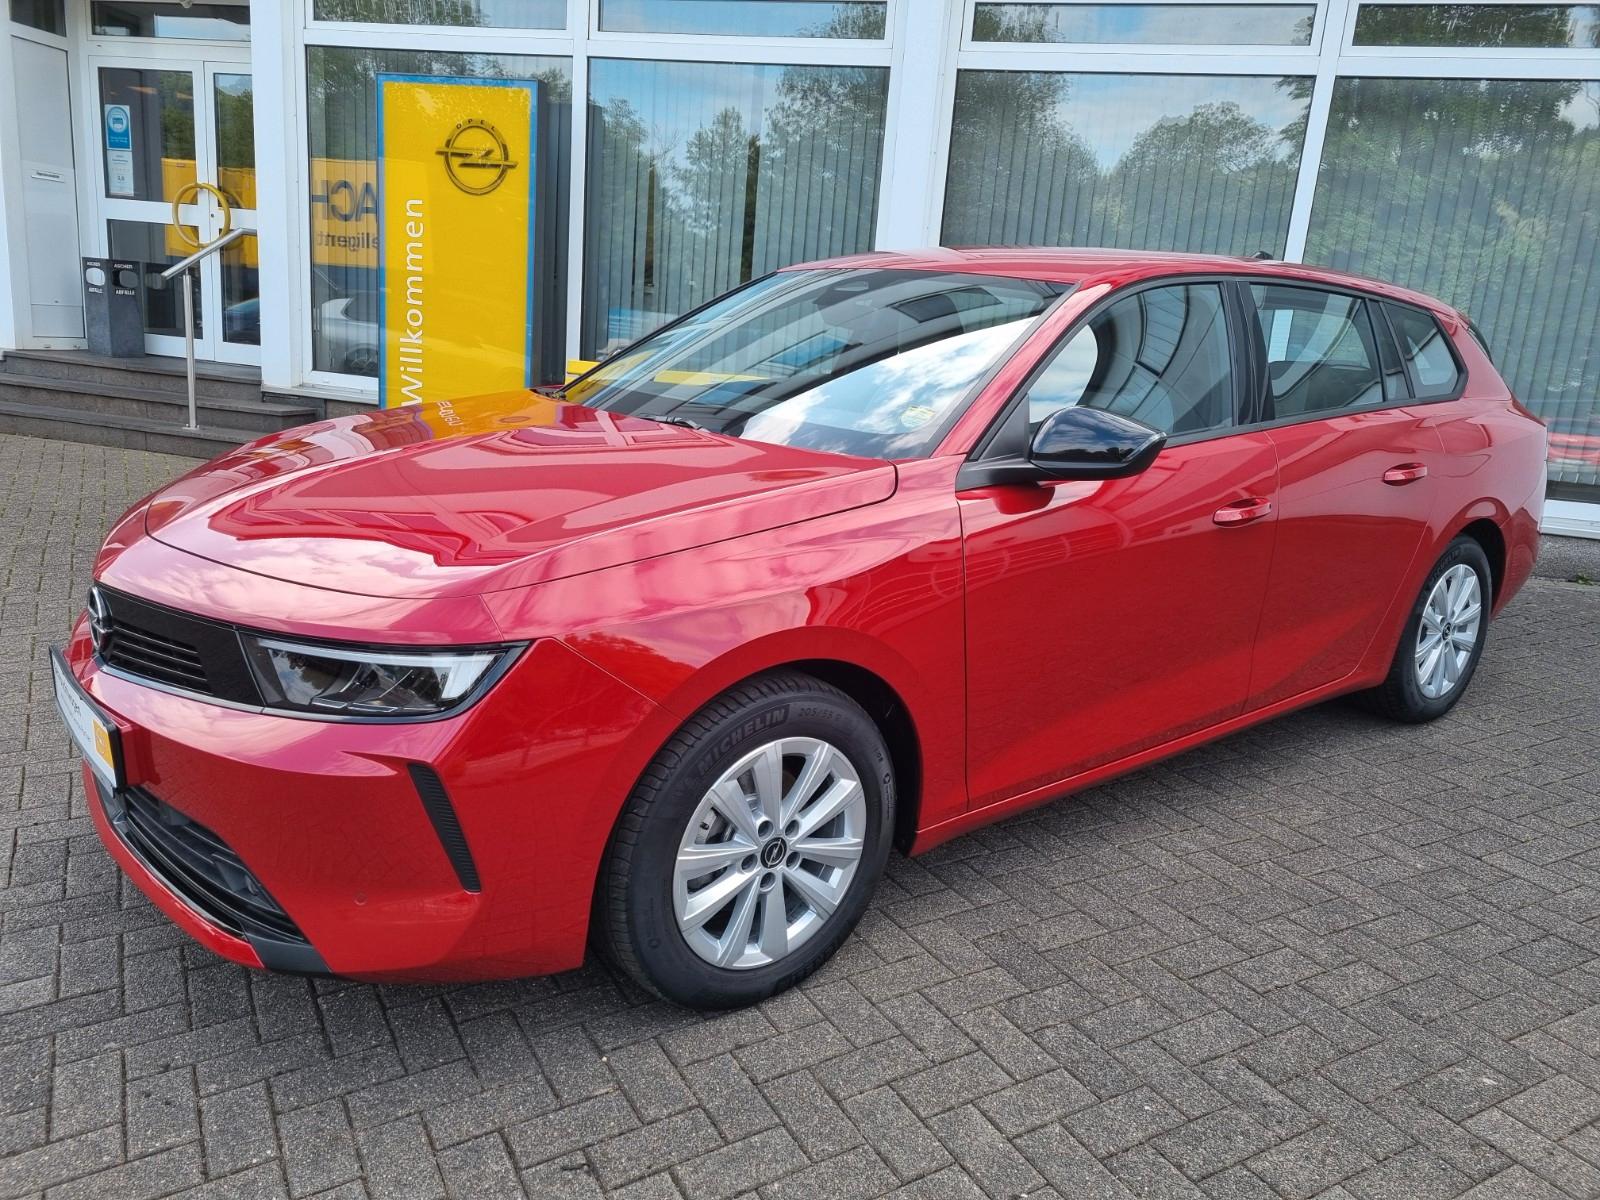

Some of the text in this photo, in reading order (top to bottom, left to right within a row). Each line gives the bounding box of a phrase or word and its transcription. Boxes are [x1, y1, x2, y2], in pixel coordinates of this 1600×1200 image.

[456, 118, 495, 132] OPEL
[400, 199, 424, 407] Willkommen
[697, 708, 786, 776] MICHELIN
